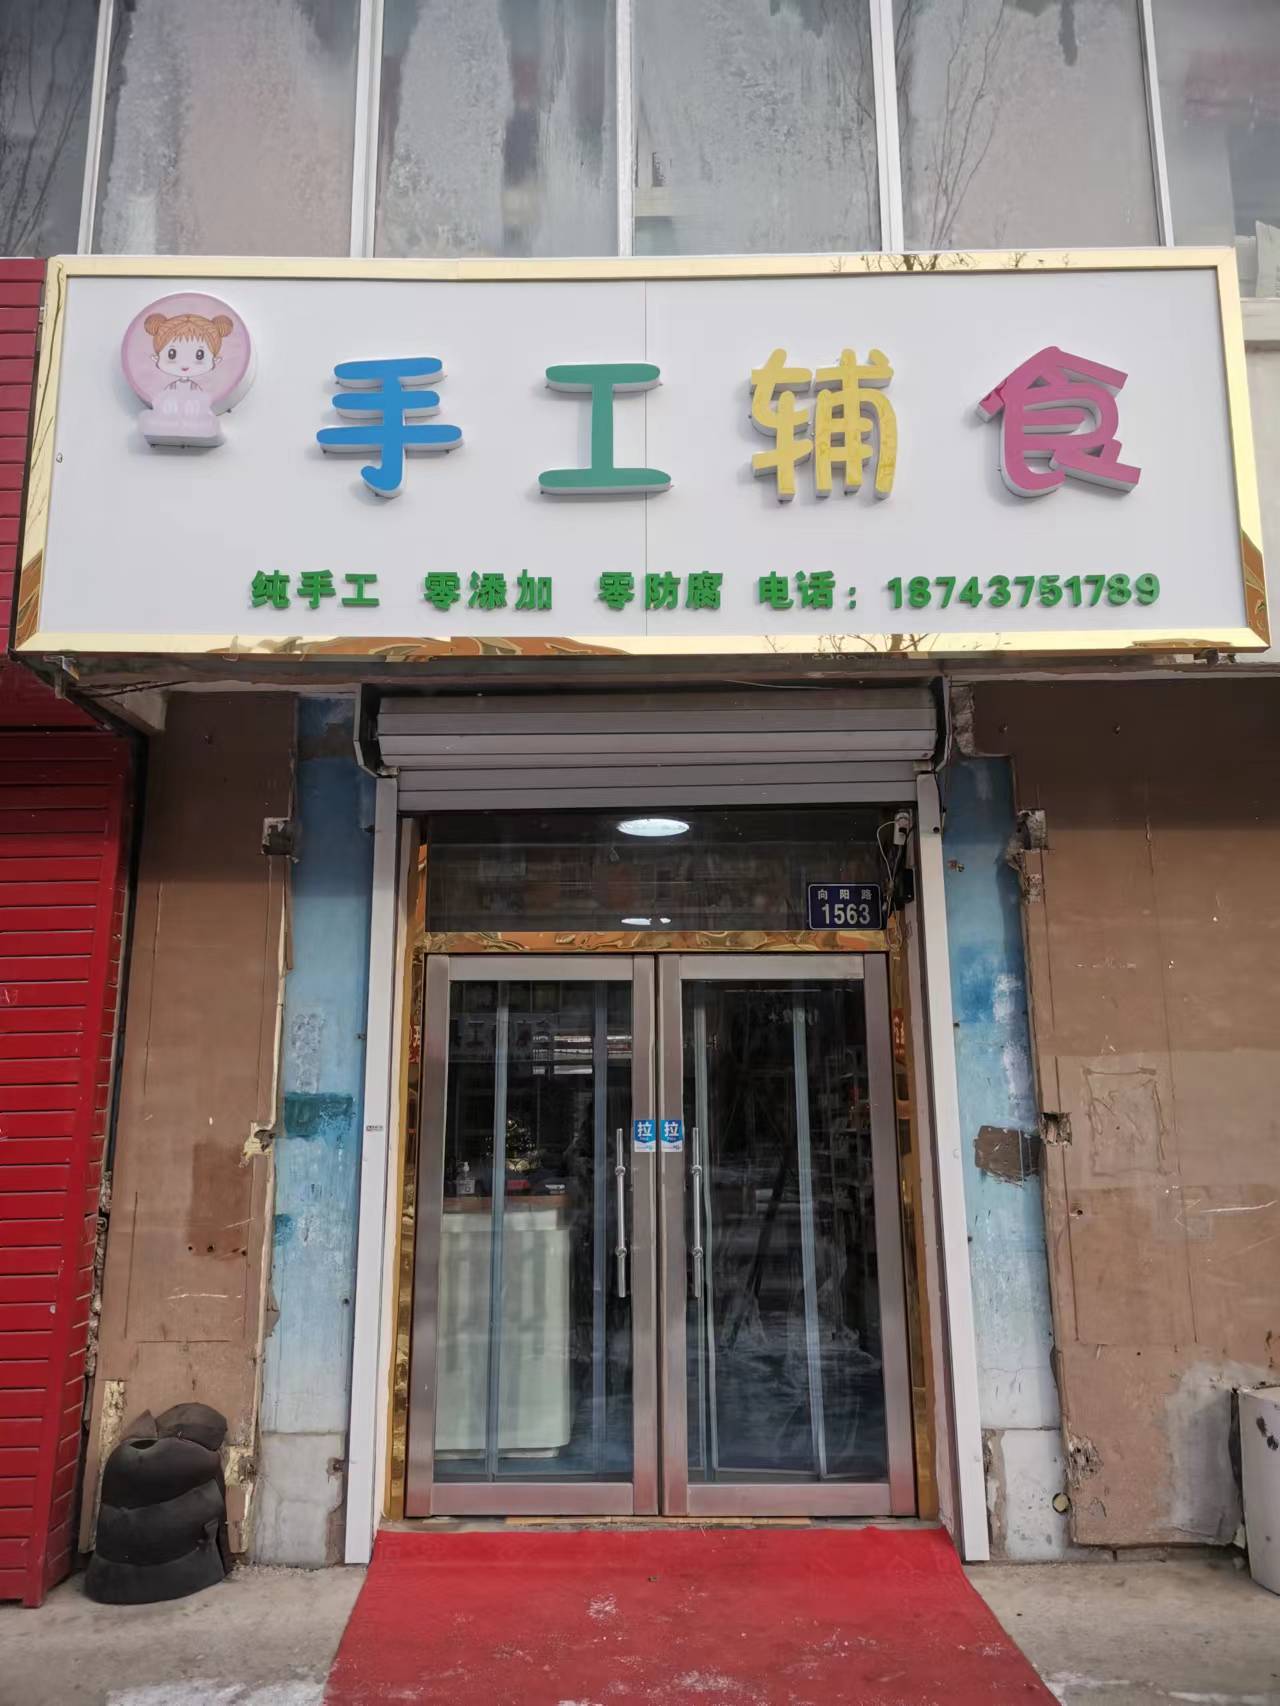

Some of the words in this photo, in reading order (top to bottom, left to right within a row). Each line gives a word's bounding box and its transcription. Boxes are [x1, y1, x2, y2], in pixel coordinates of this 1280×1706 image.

[316, 347, 1142, 500] 手工辅食
[251, 570, 379, 610] 纯手工
[424, 570, 554, 611] 零添加
[599, 571, 723, 611] 零防腐
[817, 888, 872, 900] 向阳路
[821, 903, 871, 925] 1563
[637, 1121, 653, 1137] 拉
[663, 1121, 680, 1137] 拉
